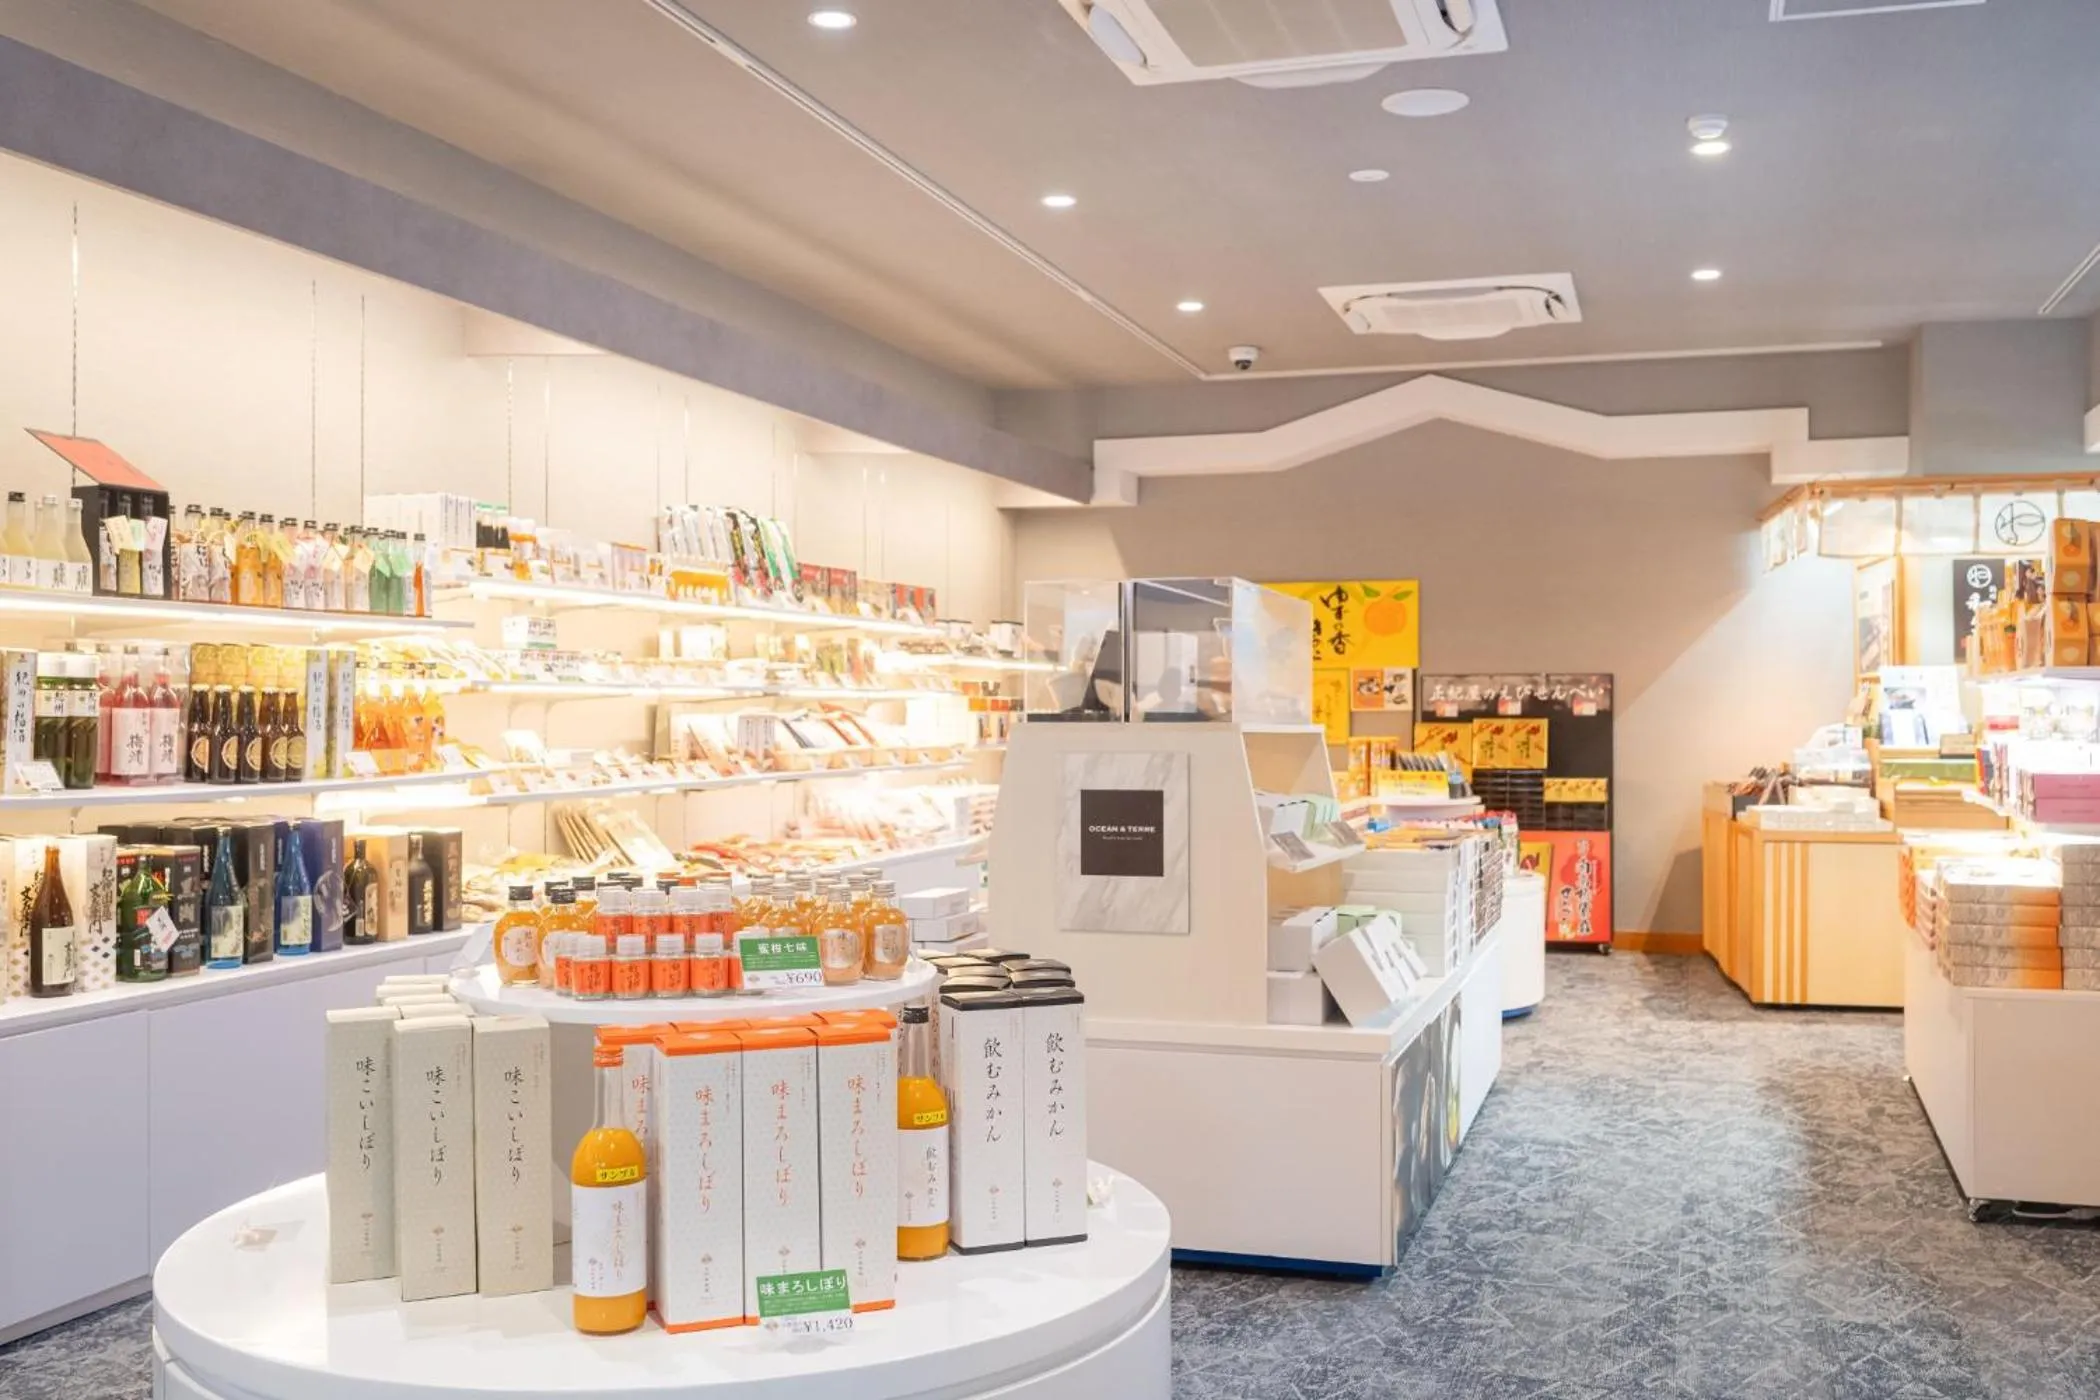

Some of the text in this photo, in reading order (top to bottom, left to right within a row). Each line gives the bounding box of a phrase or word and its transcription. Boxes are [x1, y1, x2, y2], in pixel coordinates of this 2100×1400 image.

[1088, 825, 1119, 833] OCEAN
[355, 1056, 377, 1171] 味こいしぼり
[426, 1065, 447, 1187] 味こいしぼり
[504, 1065, 525, 1187] 味こいしぼり
[847, 1074, 869, 1198] 味まろしぼり
[984, 1037, 1003, 1144] 飲むみかん
[1047, 1031, 1065, 1138] 飲むみかん
[599, 1167, 637, 1180] サンプル
[694, 1084, 716, 1214] 味まろしぼり
[771, 1079, 793, 1206] 味まろしぼり
[760, 1276, 847, 1296] 味まろしぼり
